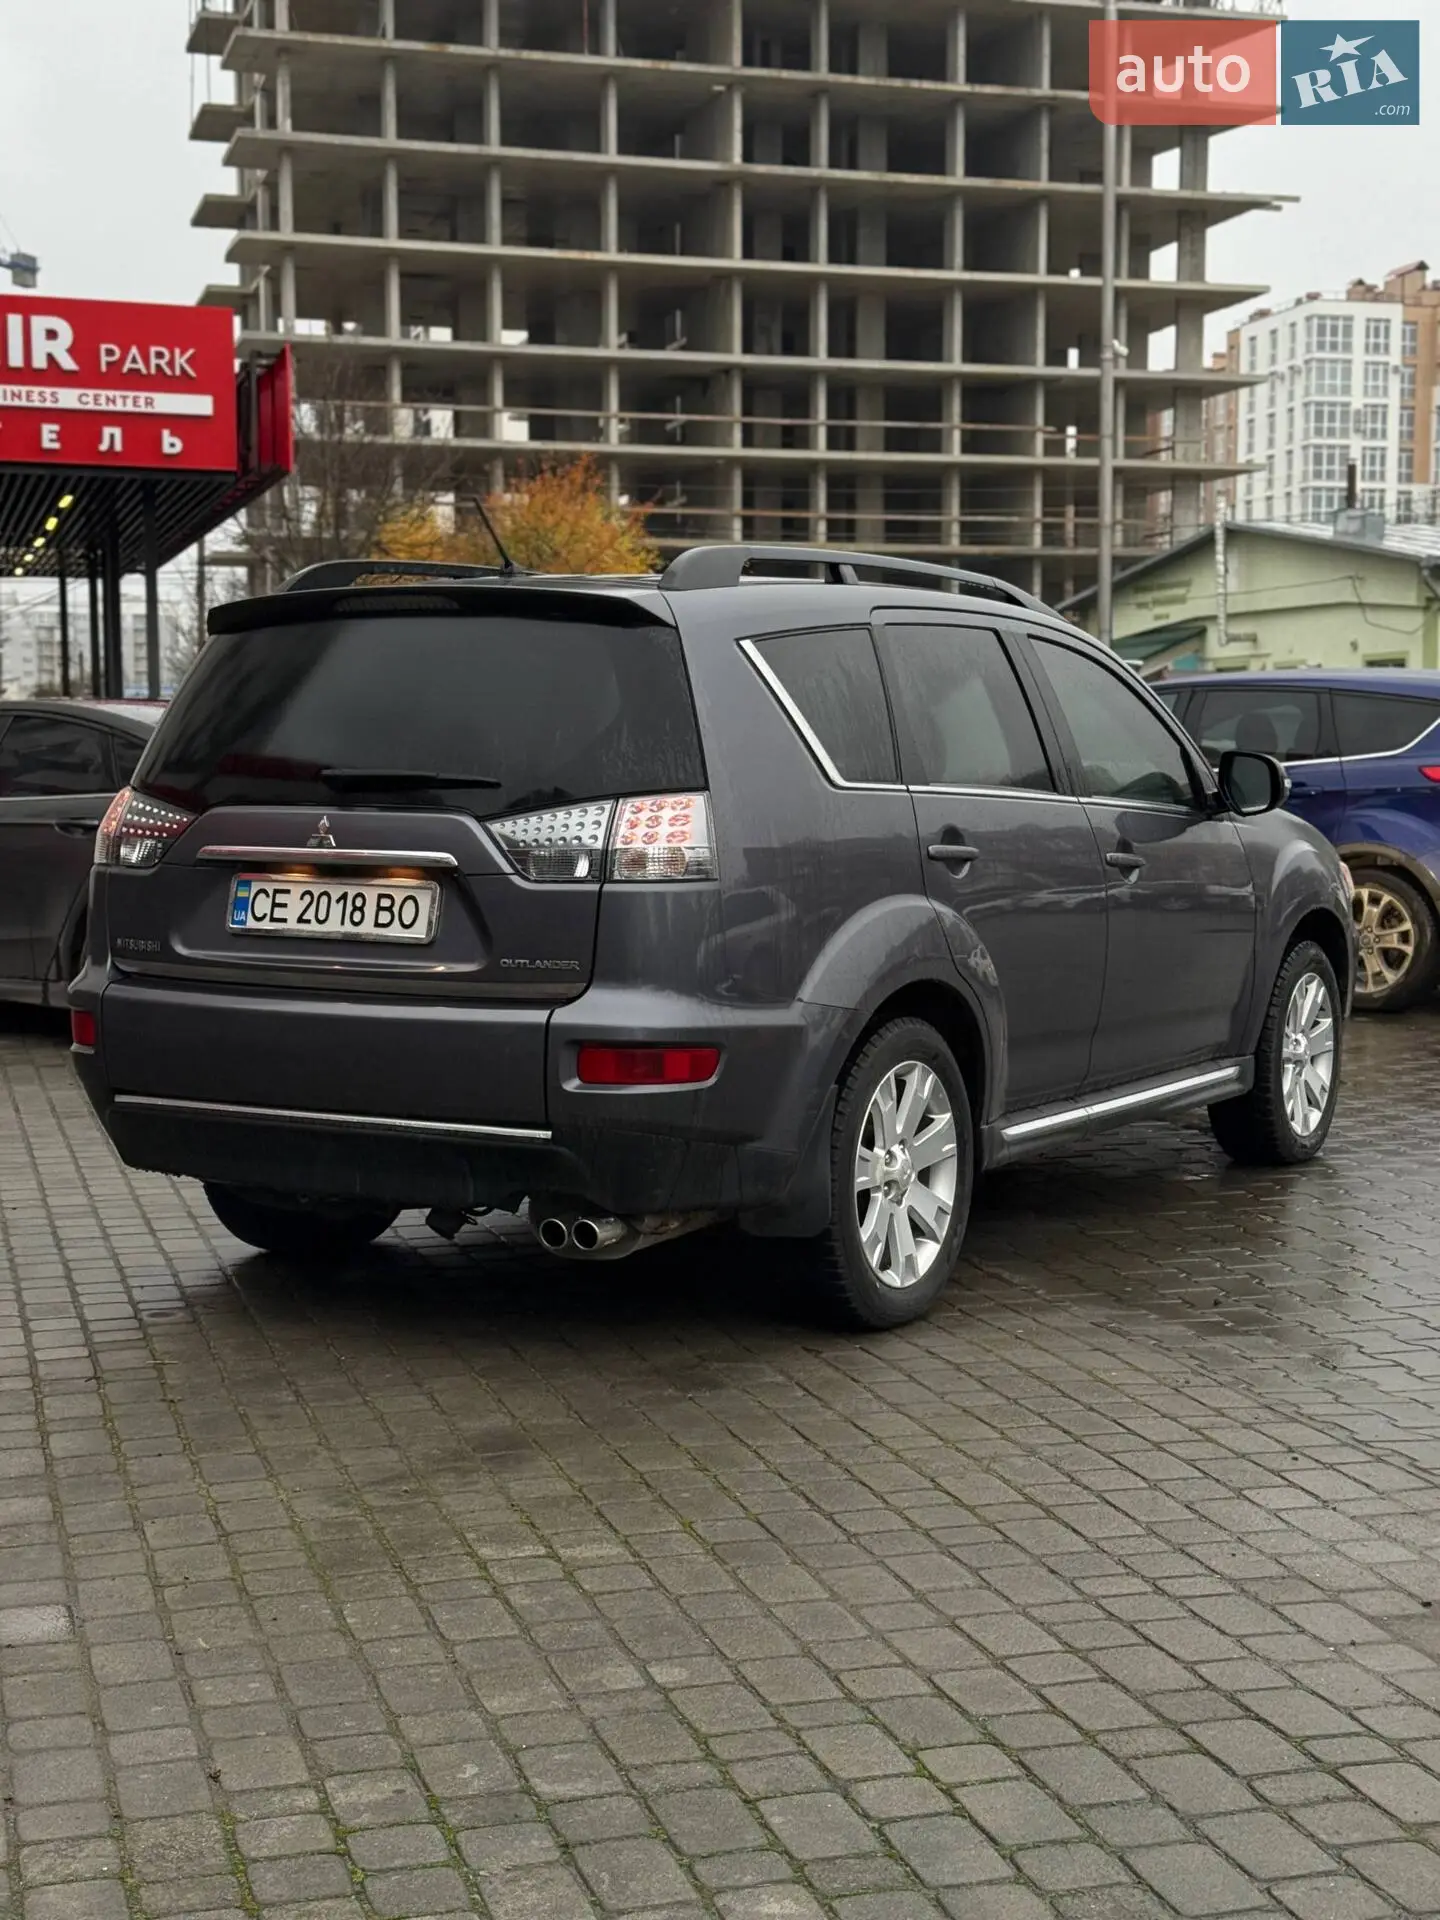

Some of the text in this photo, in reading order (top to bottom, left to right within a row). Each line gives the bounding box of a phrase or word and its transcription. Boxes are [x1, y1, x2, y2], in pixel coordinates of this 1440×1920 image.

[100, 343, 197, 378] PARK
[2, 389, 156, 409] INESS CENTER
[0, 421, 183, 455] ЕЛЬ
[233, 909, 247, 922] UA
[250, 888, 291, 923] CE
[296, 889, 367, 927] 2018
[500, 958, 580, 971] OUTLANDER
